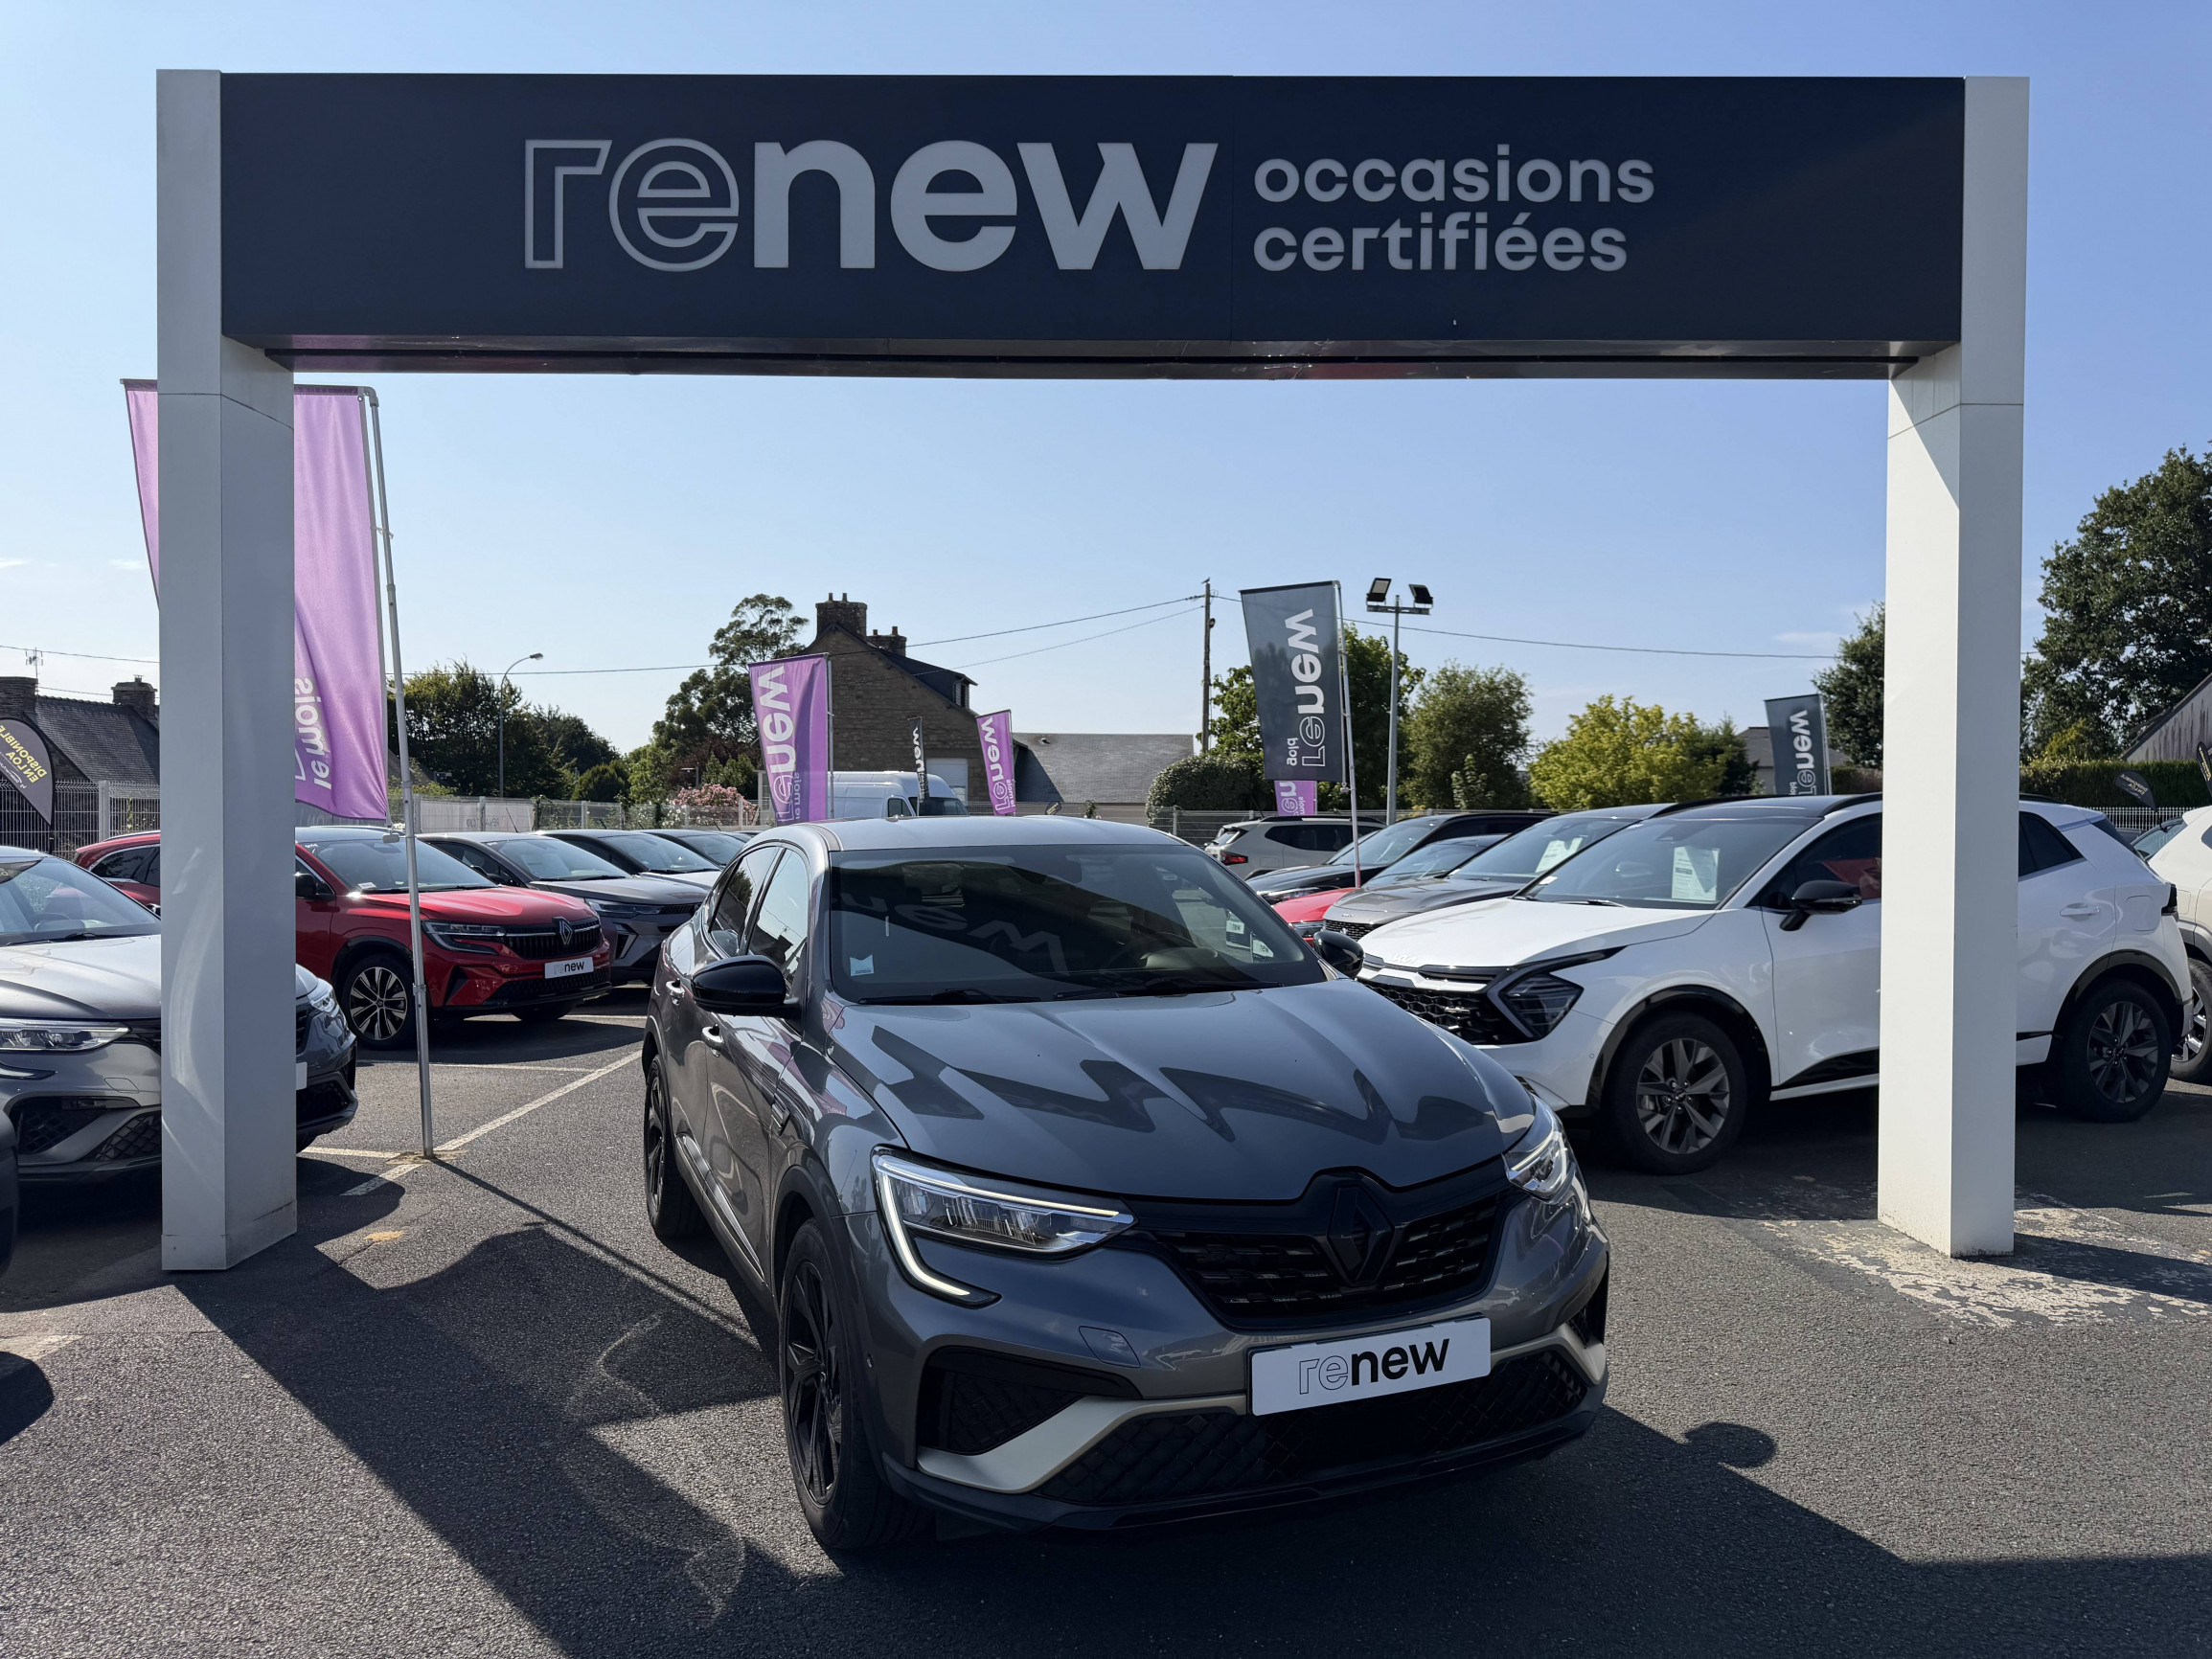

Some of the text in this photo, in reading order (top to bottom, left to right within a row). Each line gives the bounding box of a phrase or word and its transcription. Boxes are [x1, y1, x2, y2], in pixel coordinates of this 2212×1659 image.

[1253, 144, 1655, 203] occasions
[524, 137, 1219, 272] renew
[1253, 212, 1628, 272] certifiées
[1298, 1337, 1450, 1396] renew
